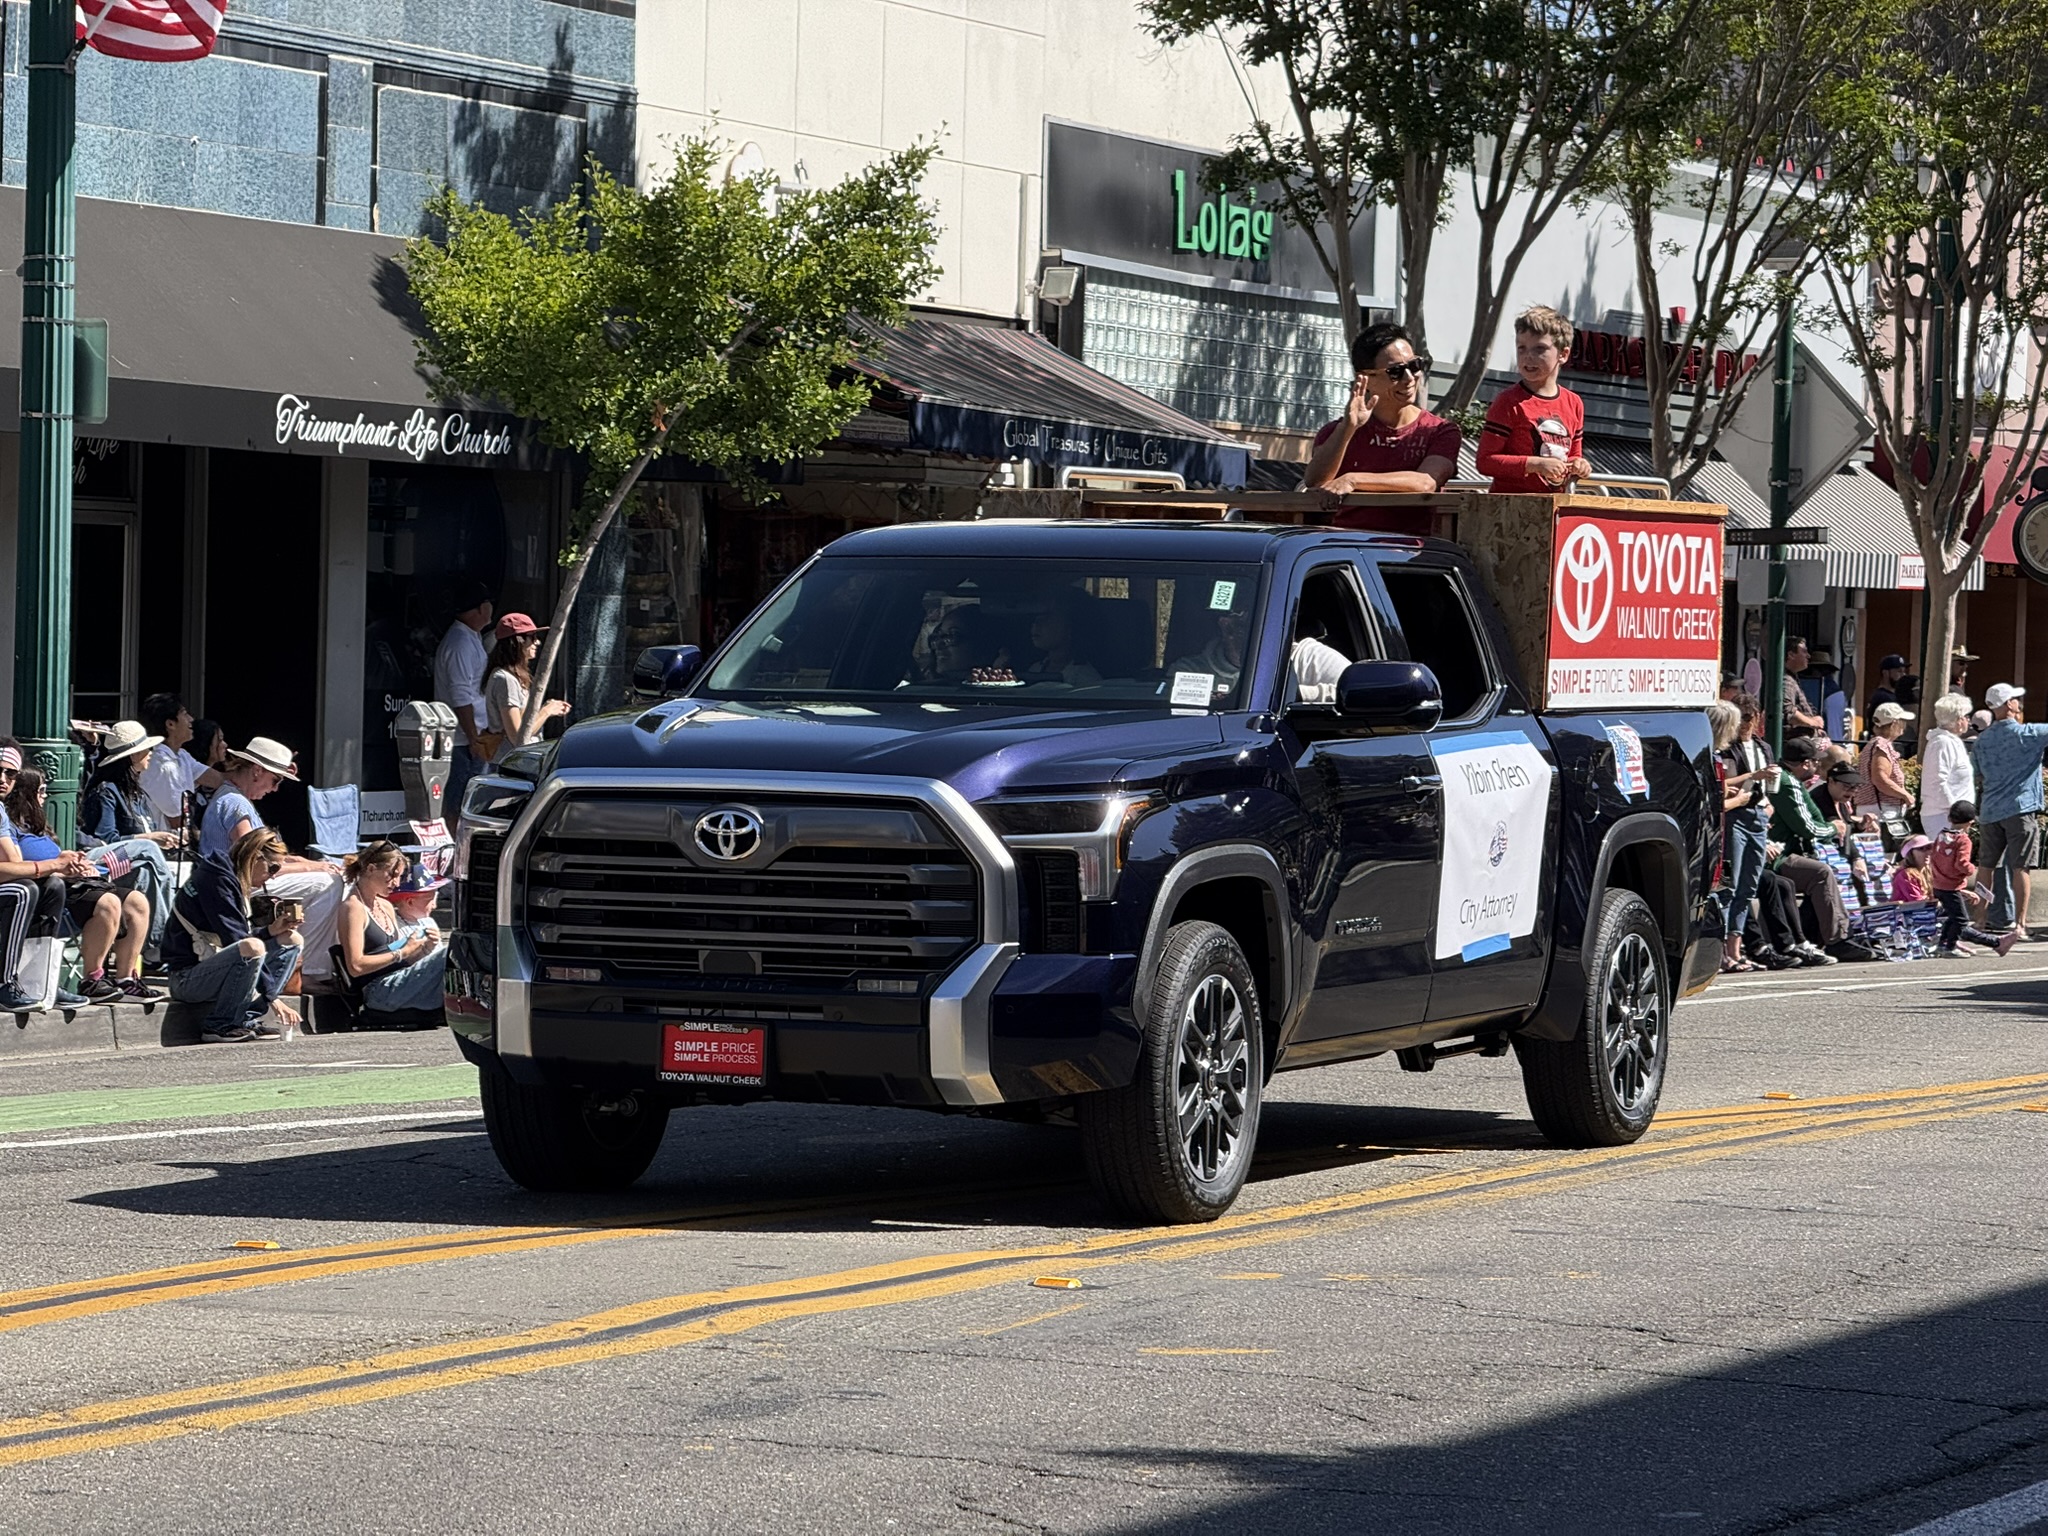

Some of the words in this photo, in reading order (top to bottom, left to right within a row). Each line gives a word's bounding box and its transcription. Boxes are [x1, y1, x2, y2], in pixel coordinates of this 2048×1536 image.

[1175, 168, 1274, 262] Lola's
[276, 393, 399, 454] Triumphant
[398, 408, 440, 461] Life
[441, 413, 511, 456] Church
[1003, 419, 1039, 448] Global
[1041, 424, 1090, 455] Treasures
[1104, 434, 1139, 464] Unique
[1142, 438, 1168, 466] Gifts
[1618, 530, 1717, 596] TOYOTA
[1901, 564, 1917, 578] PARK
[1616, 606, 1670, 640] WALNUT
[1672, 607, 1715, 641] CREEK
[1551, 669, 1592, 694] SIMPLE
[1594, 669, 1625, 693] PRICE.
[1628, 668, 1665, 693] SIMPLE
[1459, 761, 1497, 796] Yibin
[1491, 757, 1531, 790] Shen
[1459, 898, 1481, 930] City
[1479, 892, 1519, 920] Attorney
[683, 1021, 720, 1033] SIMPLE
[673, 1052, 710, 1062] SIMPLE
[711, 1054, 758, 1065] PROCESS.
[674, 1041, 718, 1052] SIMPLE
[721, 1042, 758, 1054] PRICE.
[660, 1071, 695, 1082] TOYOTA
[696, 1073, 731, 1084] WALNUT
